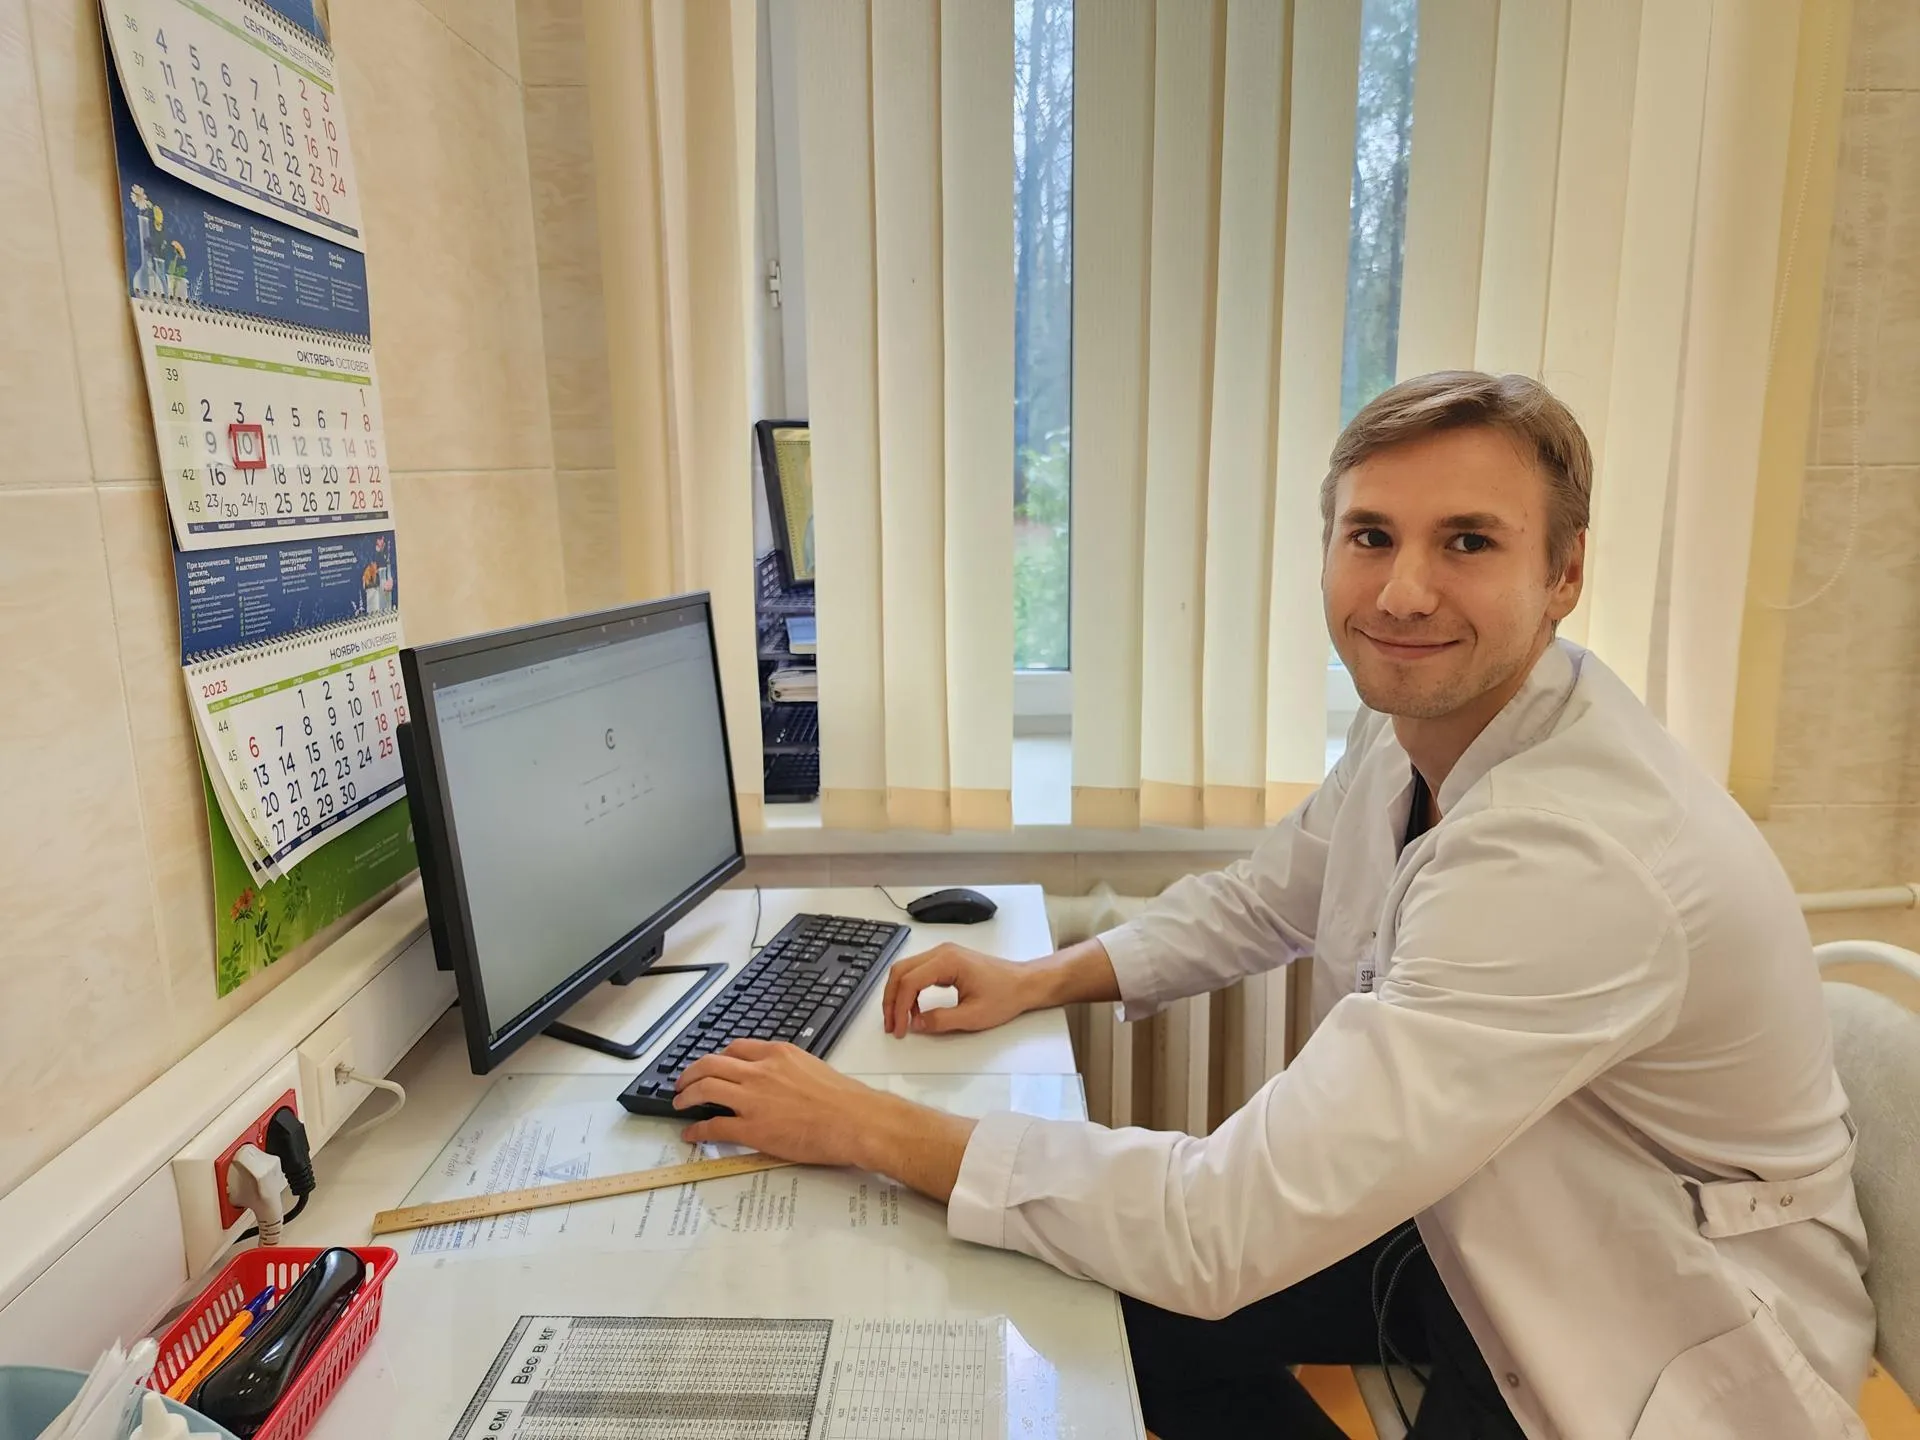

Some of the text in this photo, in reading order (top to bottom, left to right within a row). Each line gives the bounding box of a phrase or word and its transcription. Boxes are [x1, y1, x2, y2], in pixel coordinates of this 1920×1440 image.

[244, 15, 288, 52] СЕНТЯБРЬ
[156, 29, 167, 54] 4
[189, 44, 200, 70] 5
[221, 63, 232, 87] 6
[250, 79, 258, 100] 7
[278, 94, 287, 116] 8
[303, 108, 312, 128] 9
[323, 118, 337, 141] 10
[274, 65, 330, 112] 1 2 3
[160, 61, 176, 89] 11
[192, 77, 211, 106] 12
[223, 94, 240, 120] 13
[253, 108, 268, 134] 14
[280, 122, 294, 146] 15
[304, 135, 319, 158] 16
[328, 147, 338, 168] 17
[166, 95, 186, 124] 18
[199, 110, 217, 138] 19
[228, 125, 248, 152] 20
[260, 140, 274, 165] 21
[284, 152, 301, 177] 22
[309, 164, 324, 187] 23
[331, 174, 345, 196] 24
[175, 129, 197, 158] 25
[206, 144, 227, 172] 26
[236, 158, 252, 182] 27
[264, 170, 281, 195] 28
[289, 181, 306, 205] 29
[313, 191, 330, 215] 30
[152, 326, 182, 341] 2023
[297, 351, 335, 367] ОКТЯБРЬ
[336, 358, 369, 373] OCTOBER
[166, 368, 365, 406] 39 1
[172, 399, 370, 432] 40 2 3 4 5 6 7 8
[178, 432, 377, 457] 41 9 10 11 12 13 14 15
[182, 465, 381, 486] 42 16 17 18 19 20 21 22
[188, 500, 200, 513] 43
[276, 492, 292, 514] 25
[301, 492, 317, 512] 26
[327, 492, 340, 510] 27
[351, 491, 366, 509] 28
[372, 490, 384, 508] 29
[330, 632, 397, 660] НОЯБРЬ NOVEMBER
[203, 680, 228, 698] 2023
[218, 721, 228, 733] 44
[298, 689, 305, 708] 1
[323, 681, 332, 700] 2
[346, 673, 353, 691] 3
[369, 666, 376, 682] 4
[388, 660, 395, 677] 5
[229, 682, 402, 762] 45 6 7 8 9 10 11 12
[254, 764, 270, 788] 13
[279, 752, 295, 776] 14
[306, 742, 320, 764] 15
[330, 731, 344, 752] 16
[354, 723, 365, 742] 17
[375, 714, 388, 732] 18
[394, 706, 405, 725] 19
[262, 792, 279, 818] 20
[288, 780, 302, 803] 21
[311, 768, 328, 791] 22
[336, 757, 351, 780] 23
[357, 746, 372, 769] 24
[379, 737, 393, 759] 25
[272, 820, 286, 844] 27
[293, 807, 310, 832] 28
[317, 794, 334, 817] 29
[340, 782, 356, 804] 30
[511, 1327, 554, 1384] Вес в кг
[489, 1410, 510, 1431] см
